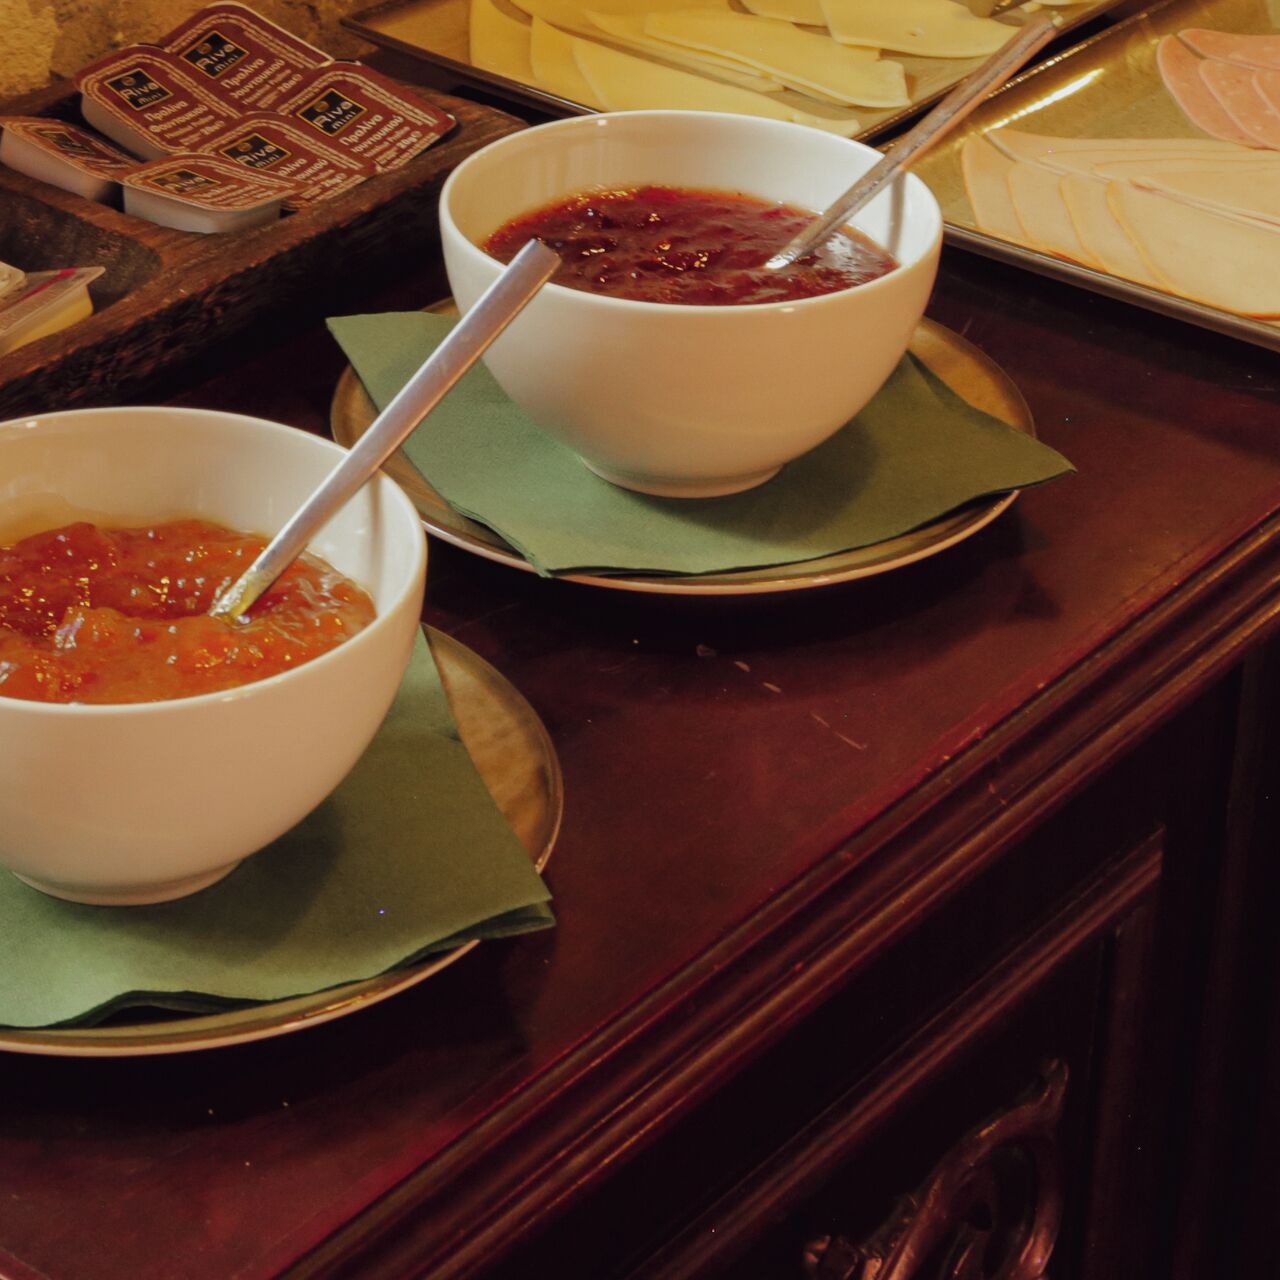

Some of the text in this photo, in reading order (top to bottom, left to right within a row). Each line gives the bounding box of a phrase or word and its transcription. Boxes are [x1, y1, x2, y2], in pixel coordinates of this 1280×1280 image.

[196, 44, 236, 70] Riva
[214, 55, 239, 72] mini
[121, 82, 160, 101] Riva
[313, 101, 354, 128] Riva
[332, 111, 357, 130] mini
[236, 144, 277, 165] Riva
